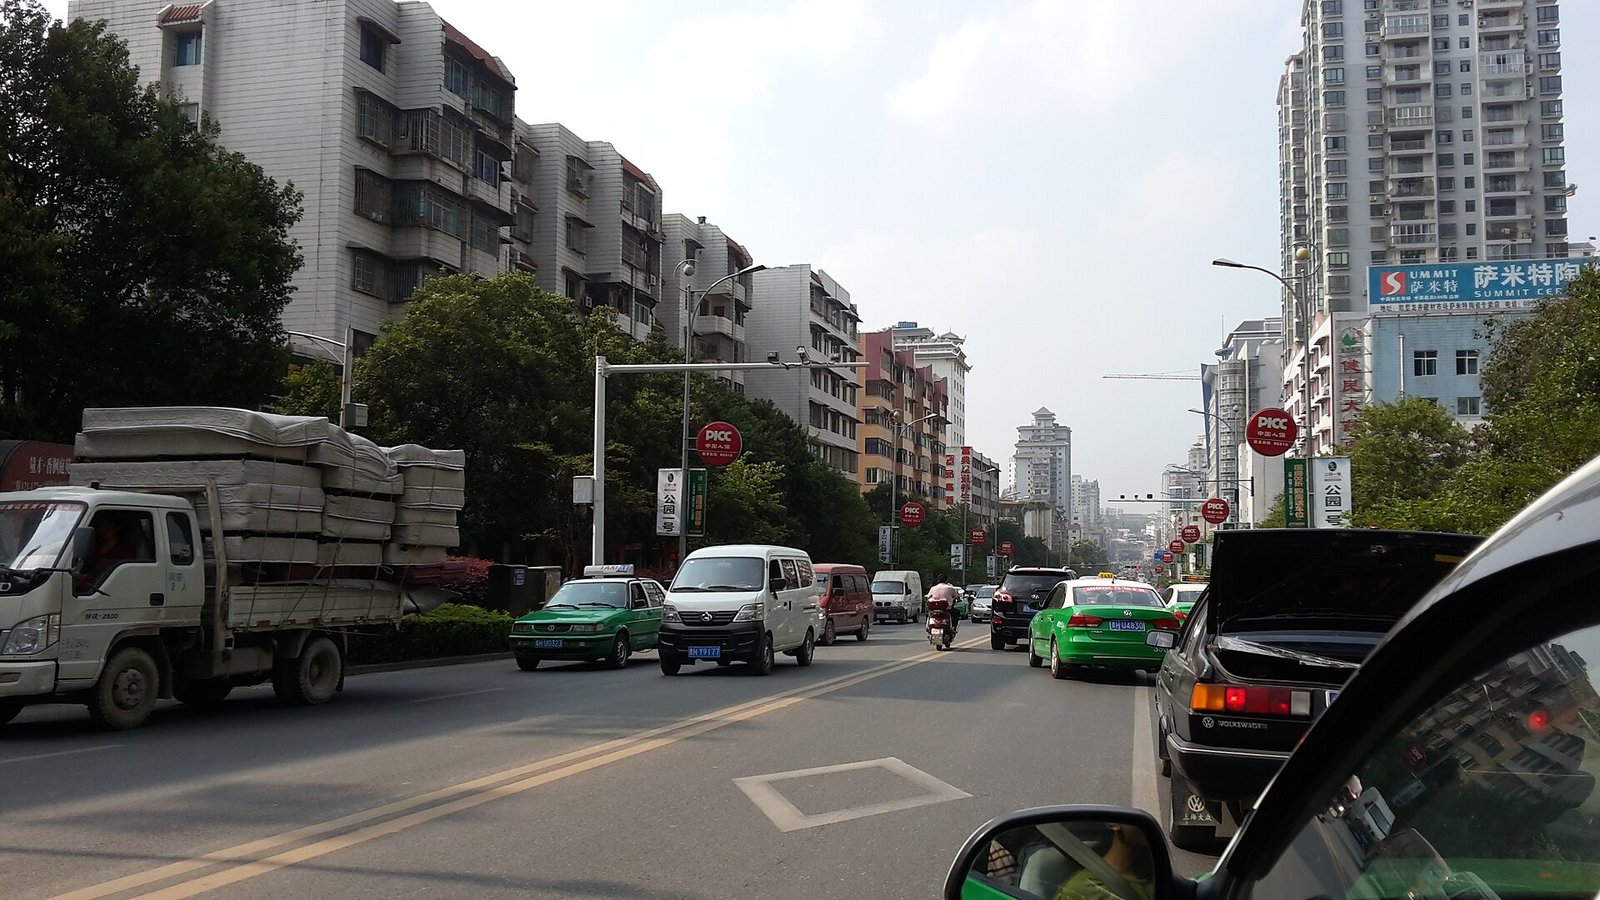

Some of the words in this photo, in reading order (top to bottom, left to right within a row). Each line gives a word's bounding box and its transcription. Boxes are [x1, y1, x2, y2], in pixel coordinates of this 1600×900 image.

[1474, 262, 1592, 288] 萨米特陶
[1410, 280, 1459, 294] 萨米特
[1474, 288, 1530, 298] SUMMIT
[1258, 416, 1288, 430] PICC
[706, 430, 732, 442] PICC
[1325, 485, 1342, 526] 公园一号
[662, 494, 676, 532] 公园一号
[1182, 813, 1212, 822] 上海大众
